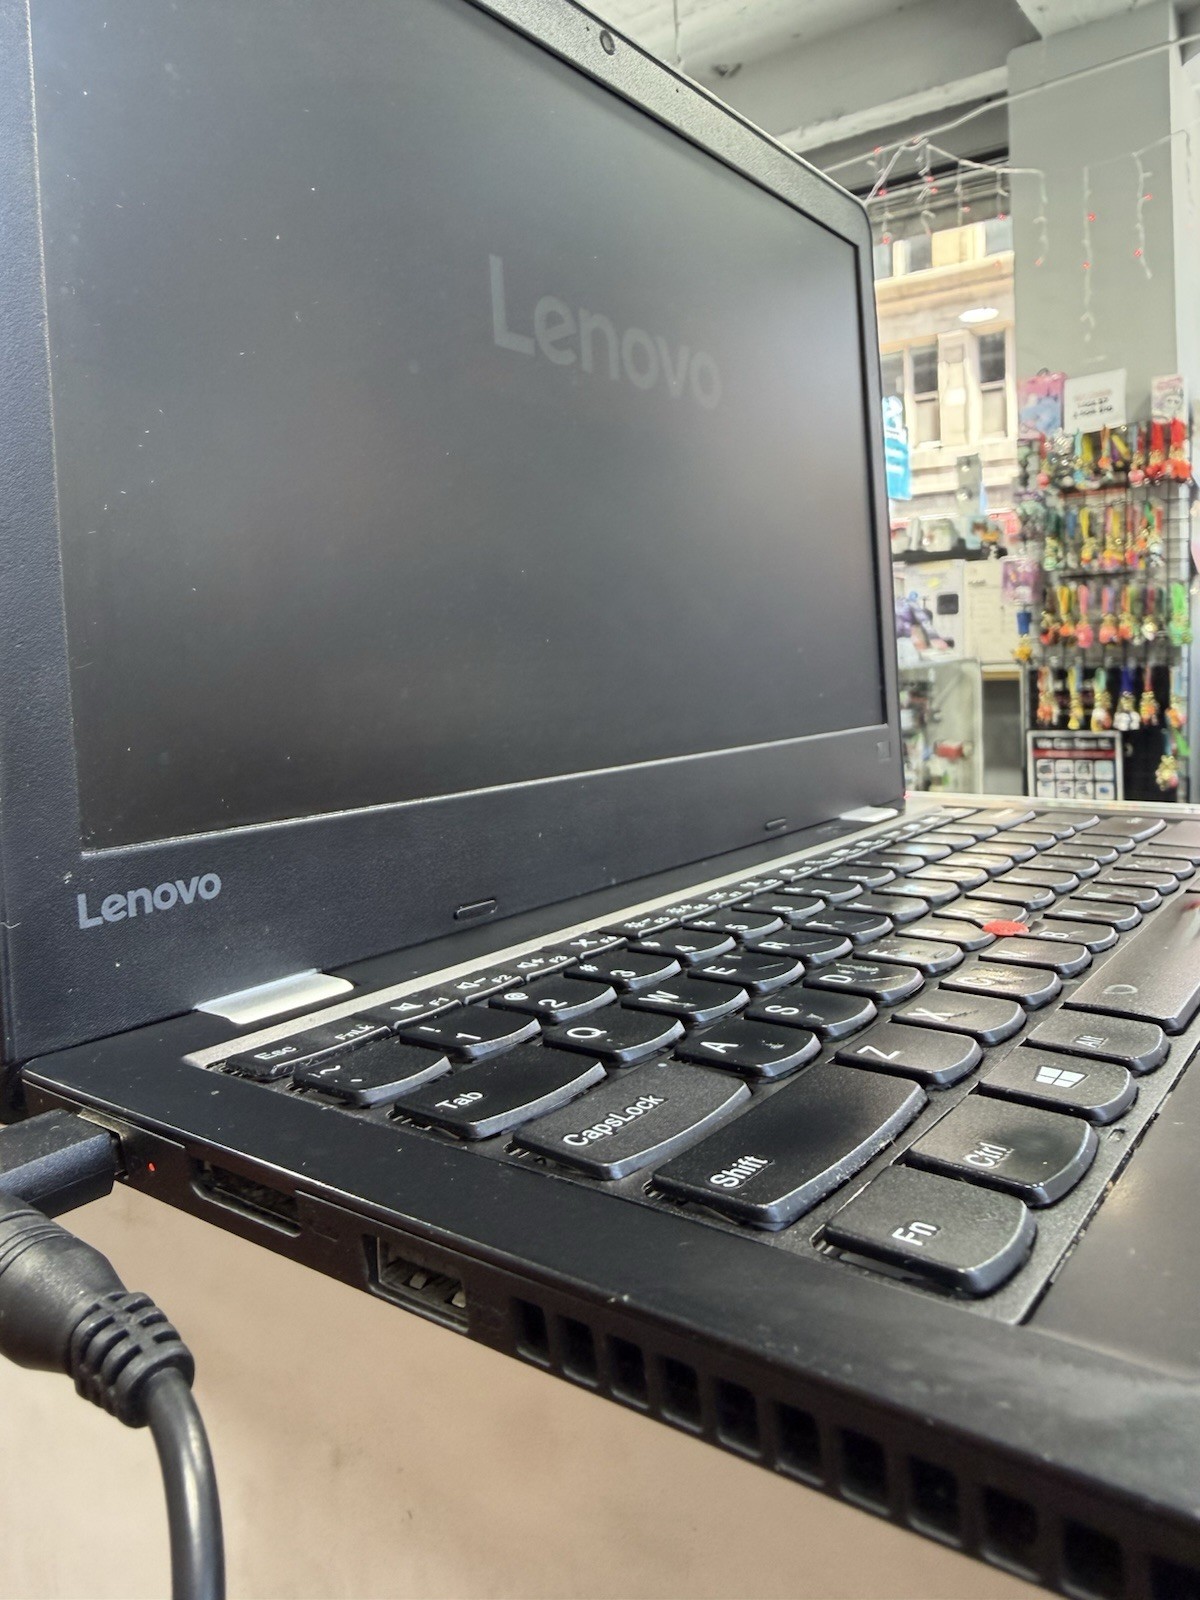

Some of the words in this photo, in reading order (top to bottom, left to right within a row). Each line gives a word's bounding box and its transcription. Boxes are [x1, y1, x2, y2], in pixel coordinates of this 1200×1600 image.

[489, 253, 722, 410] Lenovo
[77, 872, 222, 929] Lenovo
[758, 941, 791, 950] R
[609, 969, 637, 978] 3
[703, 966, 737, 976] E
[819, 974, 852, 984] D
[504, 991, 529, 1001] @
[638, 990, 680, 1003] W
[538, 998, 568, 1009] 2
[765, 1005, 800, 1016] S
[907, 1007, 955, 1022] X
[456, 1032, 482, 1041] 1
[566, 1026, 608, 1039] Q
[700, 1041, 740, 1054] A
[1074, 1034, 1105, 1048] Alt
[253, 1046, 297, 1060] Esc
[857, 1045, 900, 1060] Z
[434, 1089, 484, 1110] Tab
[562, 1093, 666, 1148] CapsLock
[961, 1141, 1009, 1169] Ctrl
[708, 1154, 770, 1189] Shift
[891, 1219, 939, 1246] Fn
